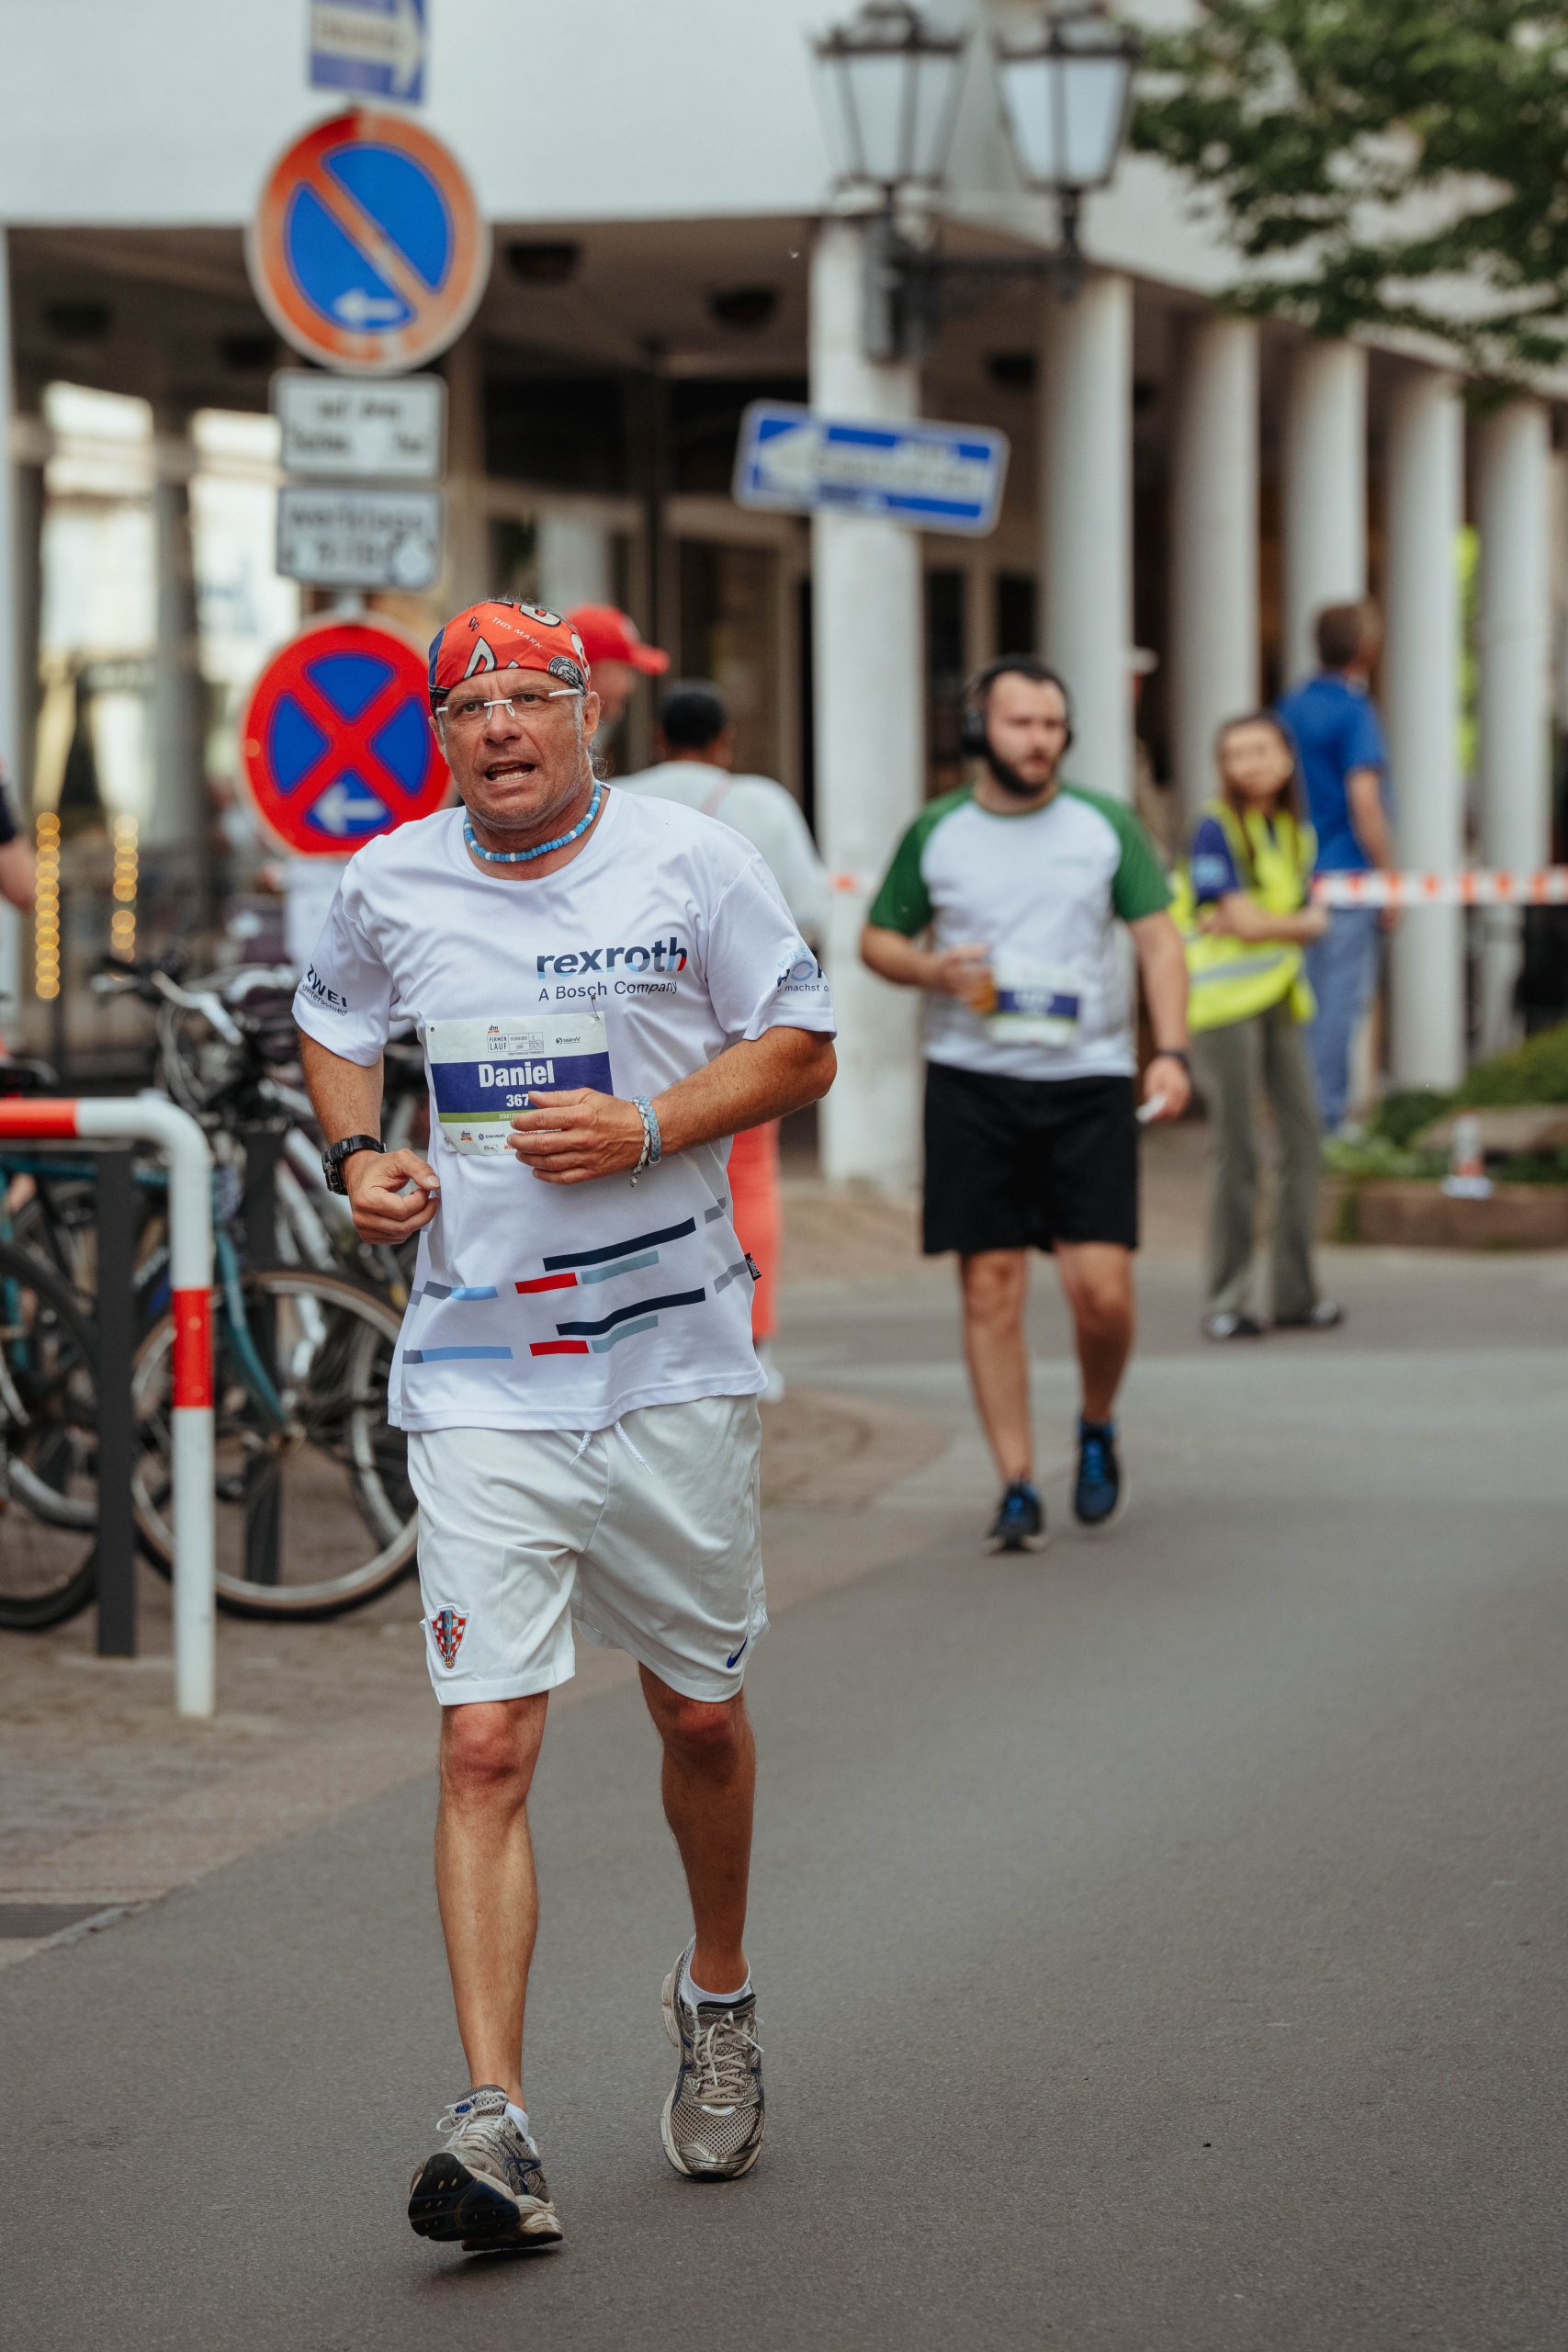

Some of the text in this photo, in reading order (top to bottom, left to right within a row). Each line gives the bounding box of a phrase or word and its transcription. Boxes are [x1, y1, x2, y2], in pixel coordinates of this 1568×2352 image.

[491, 616, 543, 650] THIS MARK
[536, 936, 688, 979] rexroth
[307, 963, 347, 1008] ZWEI
[538, 980, 677, 1001] A Bosch Company
[784, 983, 820, 992] machst
[490, 1042, 507, 1051] LAUF
[478, 1060, 556, 1088] Daniel
[506, 1093, 529, 1107] 367
